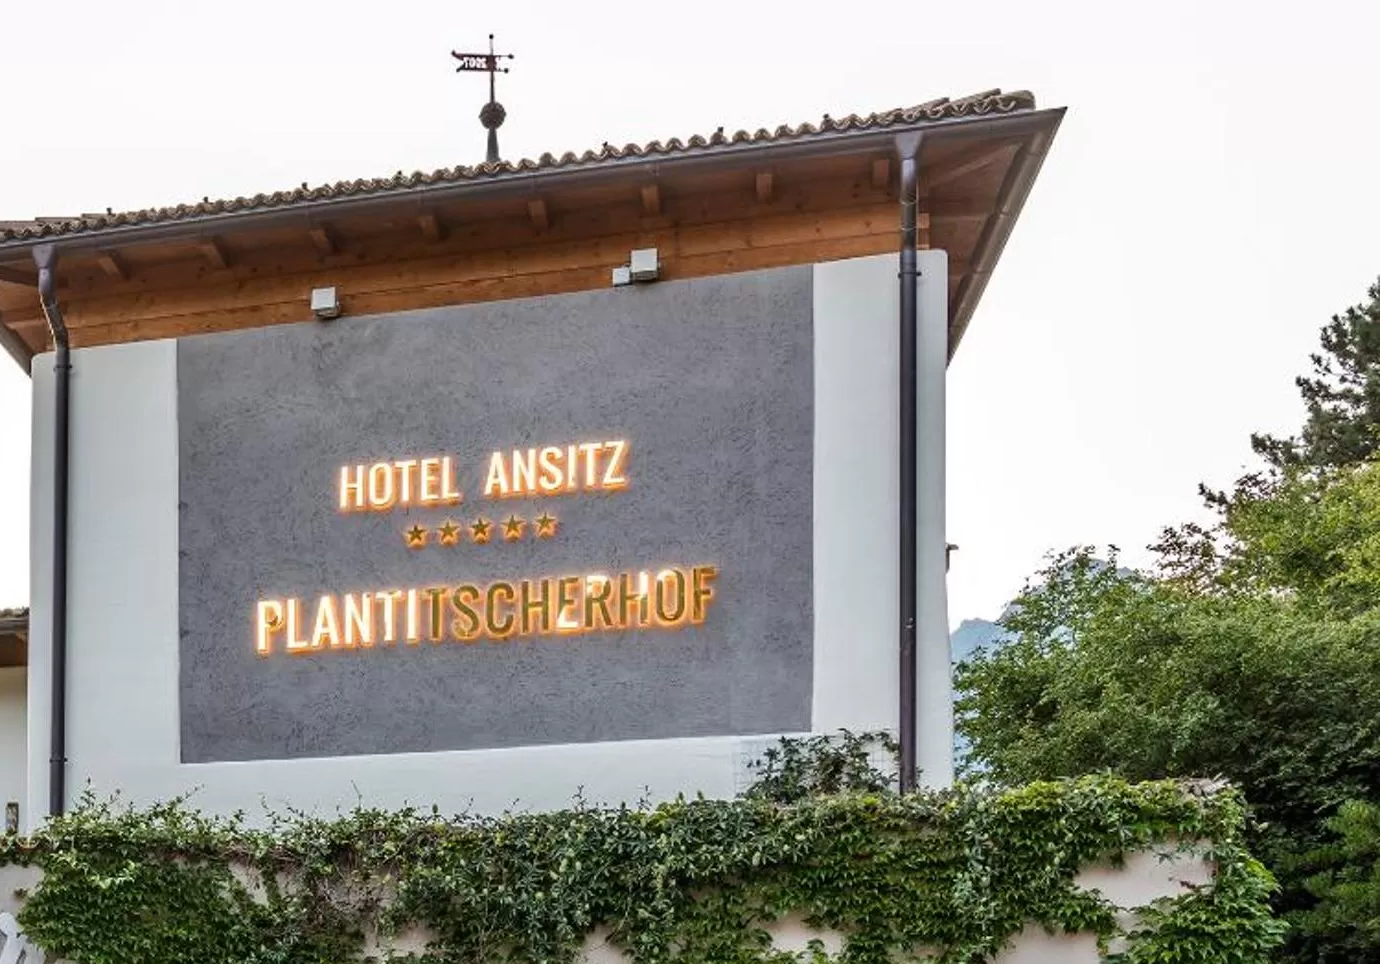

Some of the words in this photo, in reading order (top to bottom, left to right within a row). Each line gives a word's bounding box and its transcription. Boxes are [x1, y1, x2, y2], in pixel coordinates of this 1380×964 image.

[339, 456, 461, 510] HOTEL
[484, 440, 627, 497] ANSITZ
[255, 564, 718, 656] PLANTITSCHERHOF
